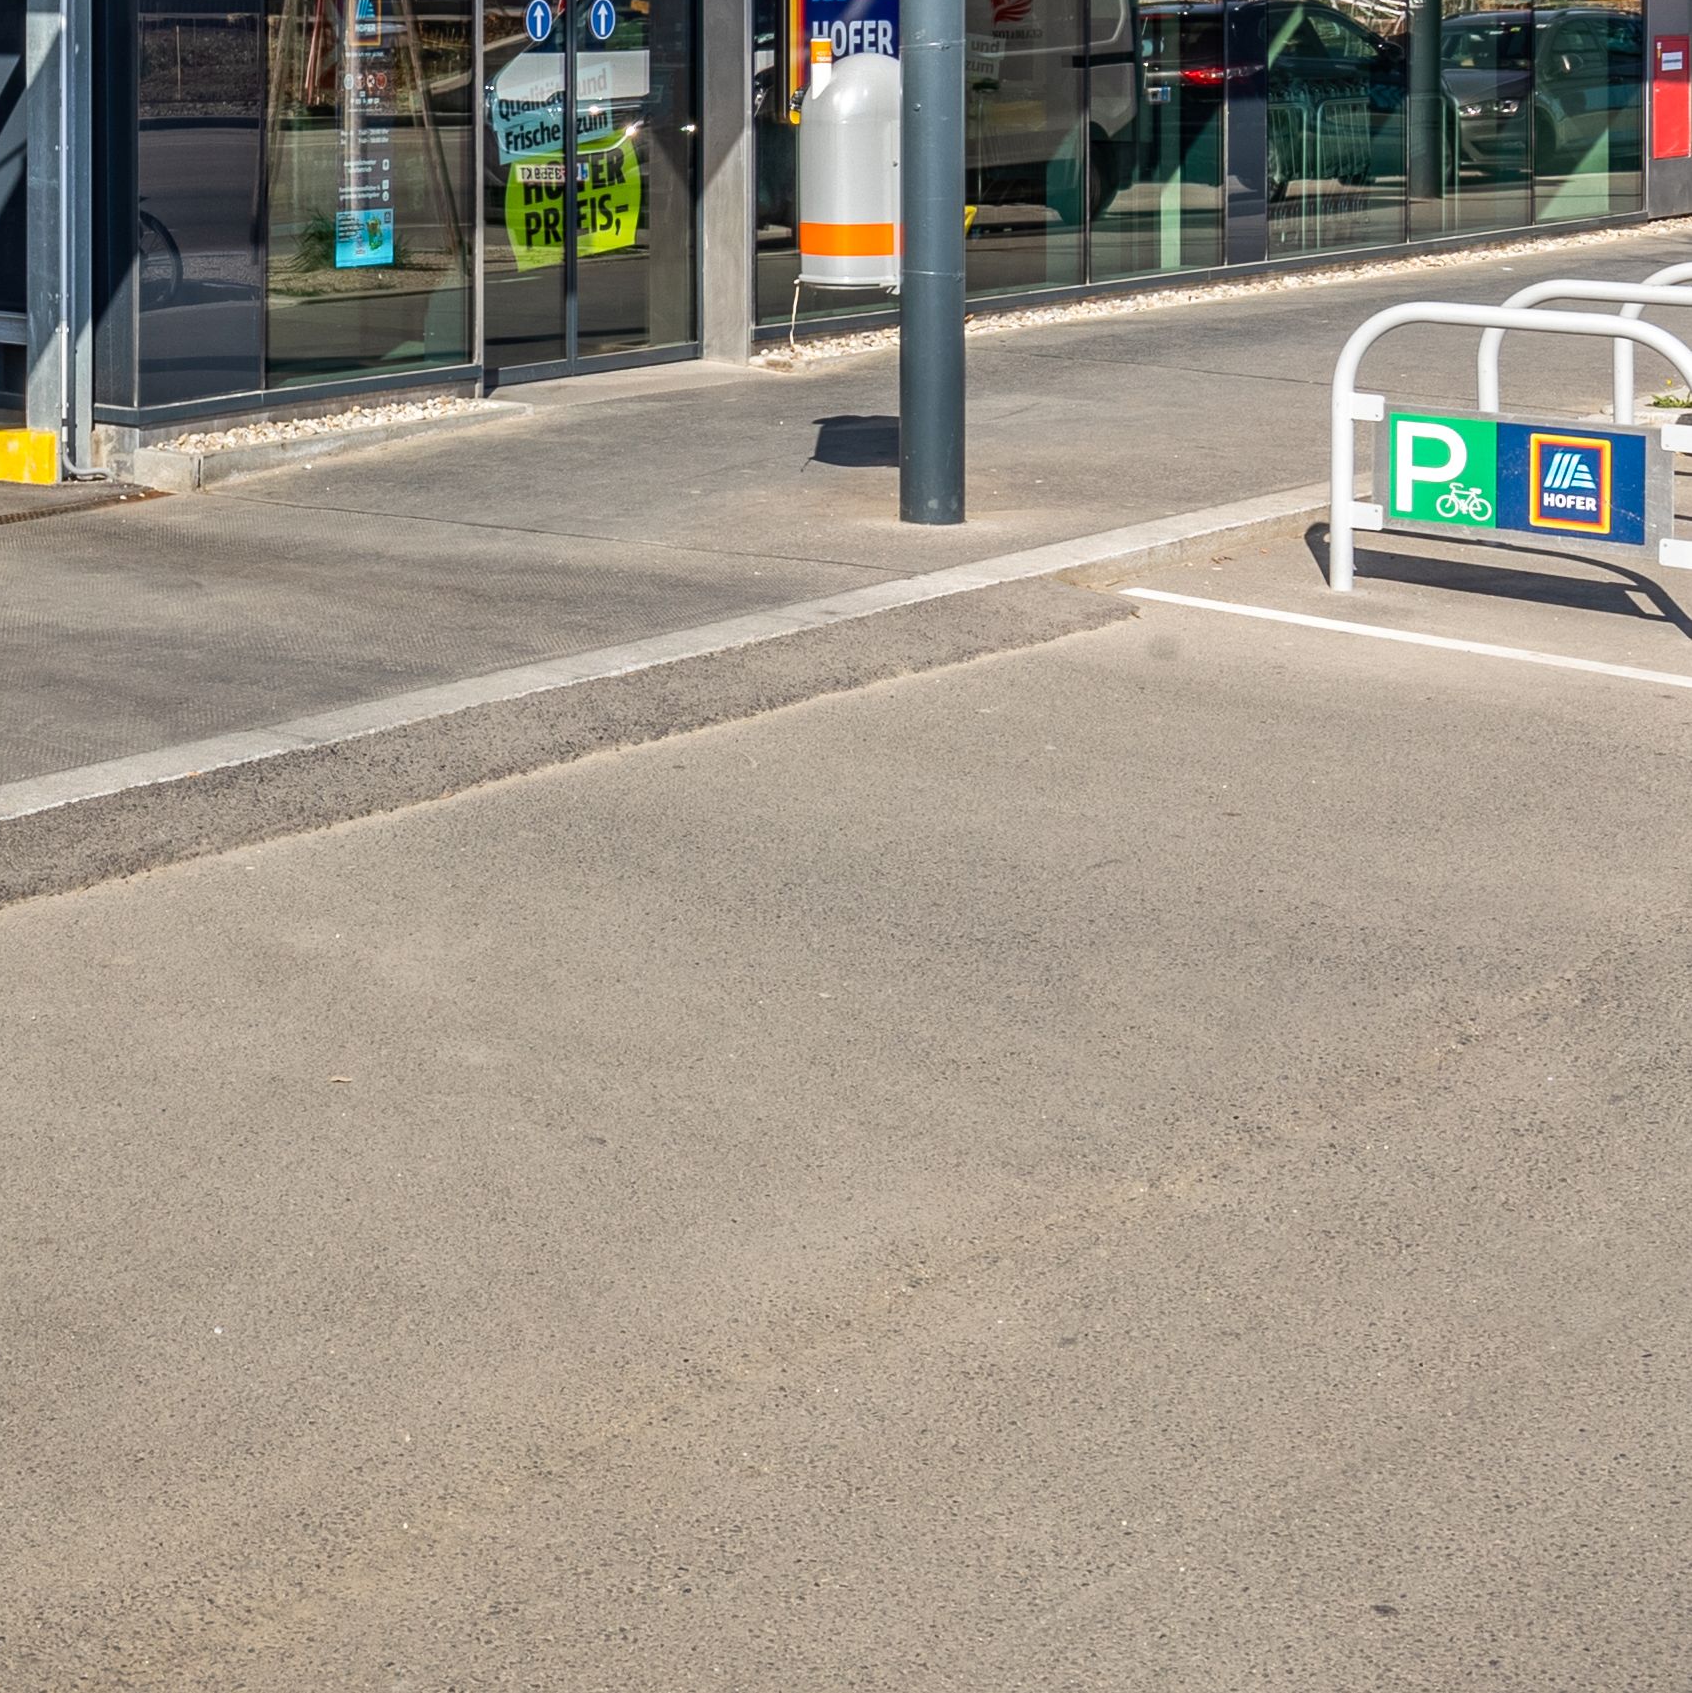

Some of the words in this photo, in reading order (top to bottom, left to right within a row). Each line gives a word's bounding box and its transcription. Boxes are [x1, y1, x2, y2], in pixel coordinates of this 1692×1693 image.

[504, 121, 562, 154] Frische
[577, 114, 609, 135] zum
[1395, 419, 1468, 513] P
[1542, 492, 1598, 512] HOFER
